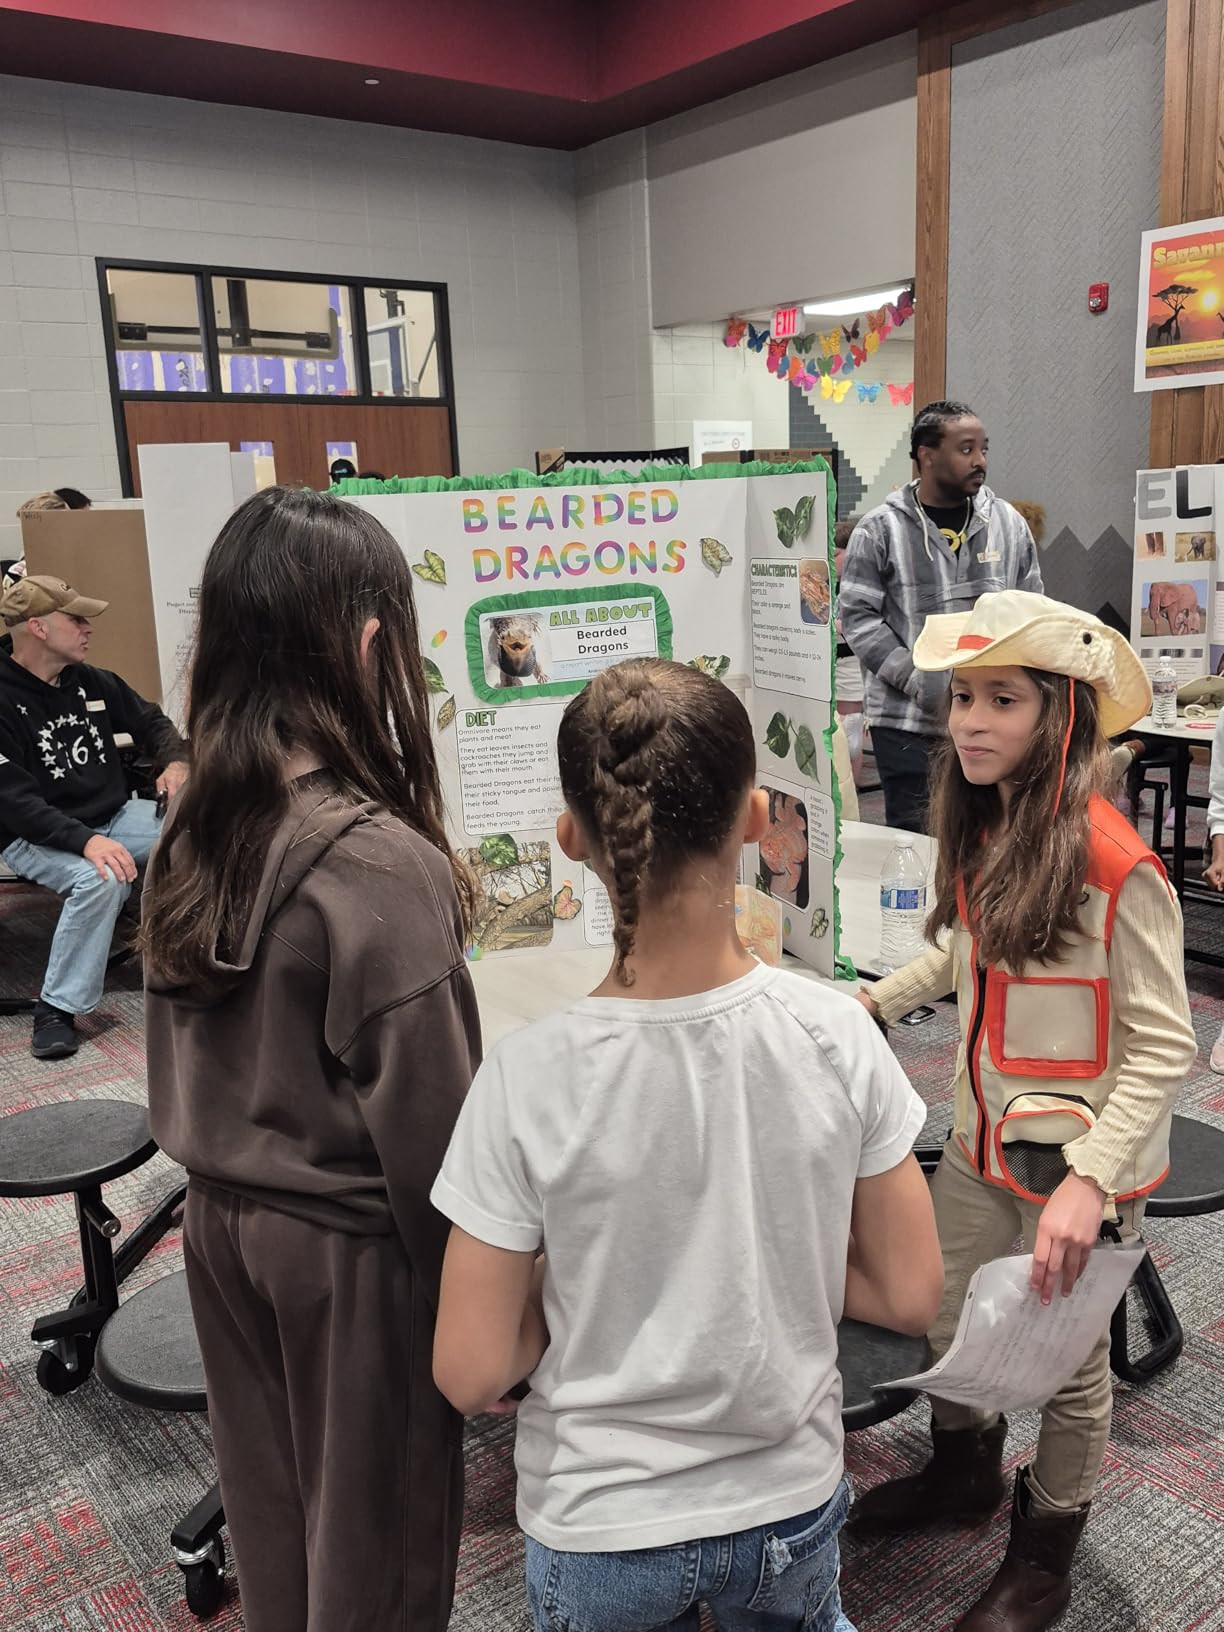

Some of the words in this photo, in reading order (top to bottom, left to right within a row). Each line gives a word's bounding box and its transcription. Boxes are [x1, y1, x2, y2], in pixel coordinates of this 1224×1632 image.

[775, 307, 797, 337] EXIT
[1137, 470, 1213, 520] EL
[462, 488, 679, 533] BEARDED
[472, 539, 687, 583] DRAGONS
[549, 609, 580, 627] ALL
[585, 602, 652, 623] ABOUT
[577, 626, 627, 640] Bearded
[578, 642, 629, 654] Dragons
[465, 710, 497, 727] DIET
[458, 728, 490, 736] Omnivore
[459, 736, 479, 744] plants
[460, 746, 475, 755] They
[460, 753, 501, 761] cockroaches
[502, 751, 516, 759] they
[461, 761, 477, 770] grab
[463, 782, 492, 790] Bearded
[493, 780, 522, 788] Dragons
[481, 790, 501, 798] sticky
[466, 813, 495, 821] Bearded
